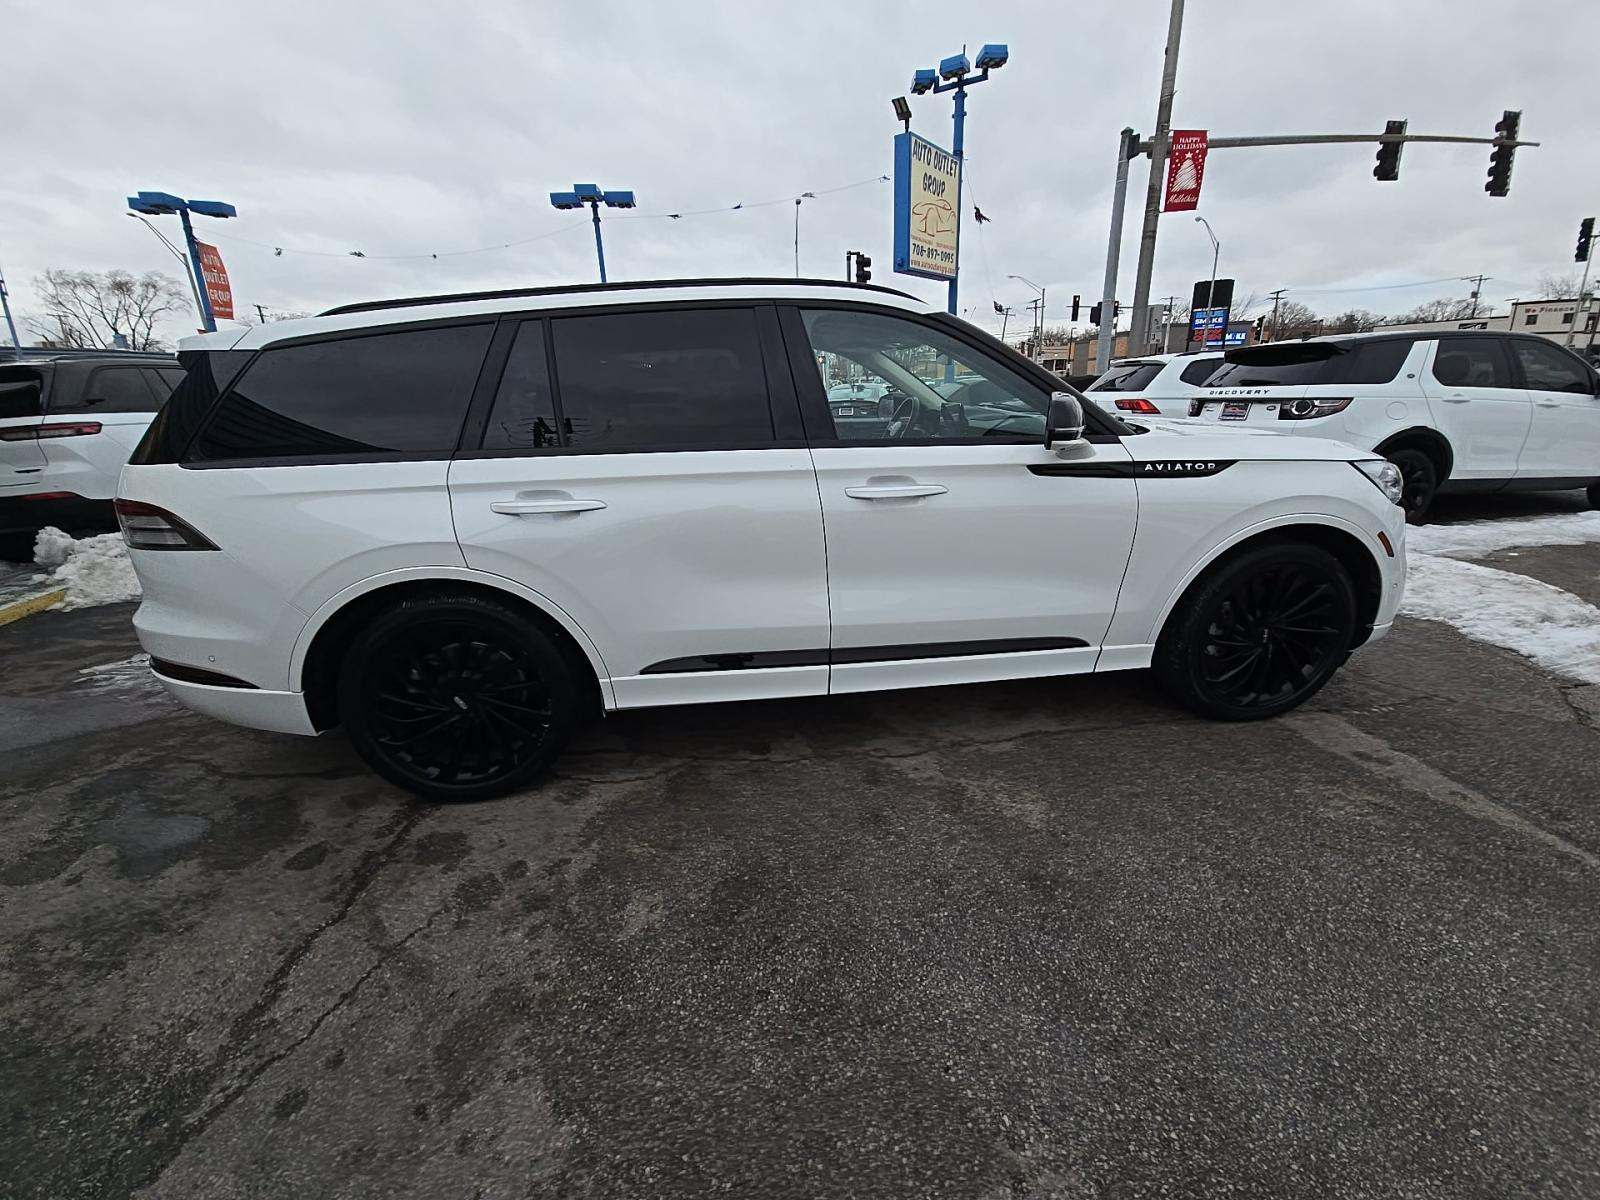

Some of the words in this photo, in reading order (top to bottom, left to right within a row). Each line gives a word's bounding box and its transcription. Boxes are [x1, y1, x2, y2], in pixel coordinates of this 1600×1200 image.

[1173, 142, 1207, 150] HOLIDAYS
[913, 140, 932, 166] AUTO
[934, 151, 958, 179] OUTLET
[923, 172, 946, 198] GROUP
[203, 253, 221, 266] AUTO
[204, 271, 228, 285] OUTLET
[208, 288, 231, 303] GROUP
[1144, 462, 1216, 471] AVIATOR
